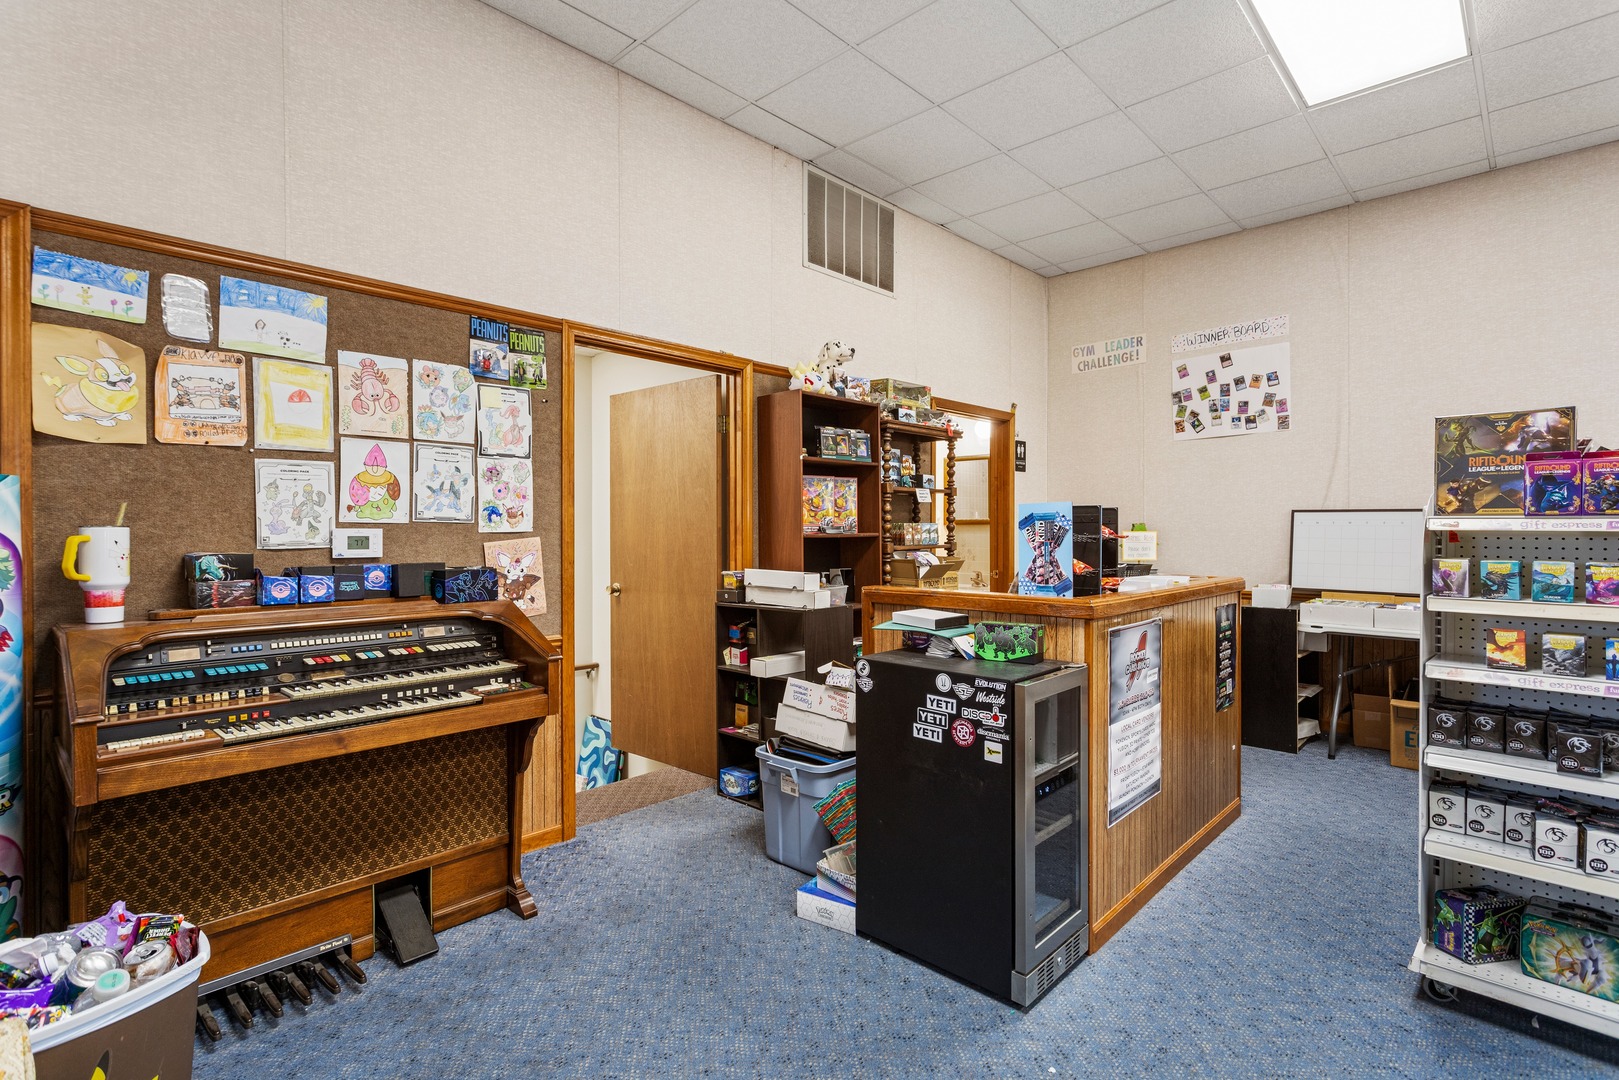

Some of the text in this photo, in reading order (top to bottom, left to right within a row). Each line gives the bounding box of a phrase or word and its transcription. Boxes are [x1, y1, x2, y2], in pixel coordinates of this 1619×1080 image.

[471, 318, 509, 342] PEANUTS
[1186, 321, 1270, 346] WINNER BOARD
[510, 332, 545, 354] PEANUTS
[1072, 336, 1144, 358] GYM LEADER
[1078, 349, 1140, 372] CHALLENGE!
[1468, 454, 1526, 466] RIFTBOUN
[1520, 520, 1546, 530] gift
[1552, 521, 1602, 530] express
[975, 679, 1006, 692] EVOLUTION
[1518, 677, 1545, 687] gift
[1549, 682, 1600, 693] express
[928, 697, 954, 711] YETI
[976, 690, 1006, 705] Westside
[920, 710, 946, 726] YETI
[915, 726, 940, 740] YETI
[977, 728, 1009, 740] discmania
